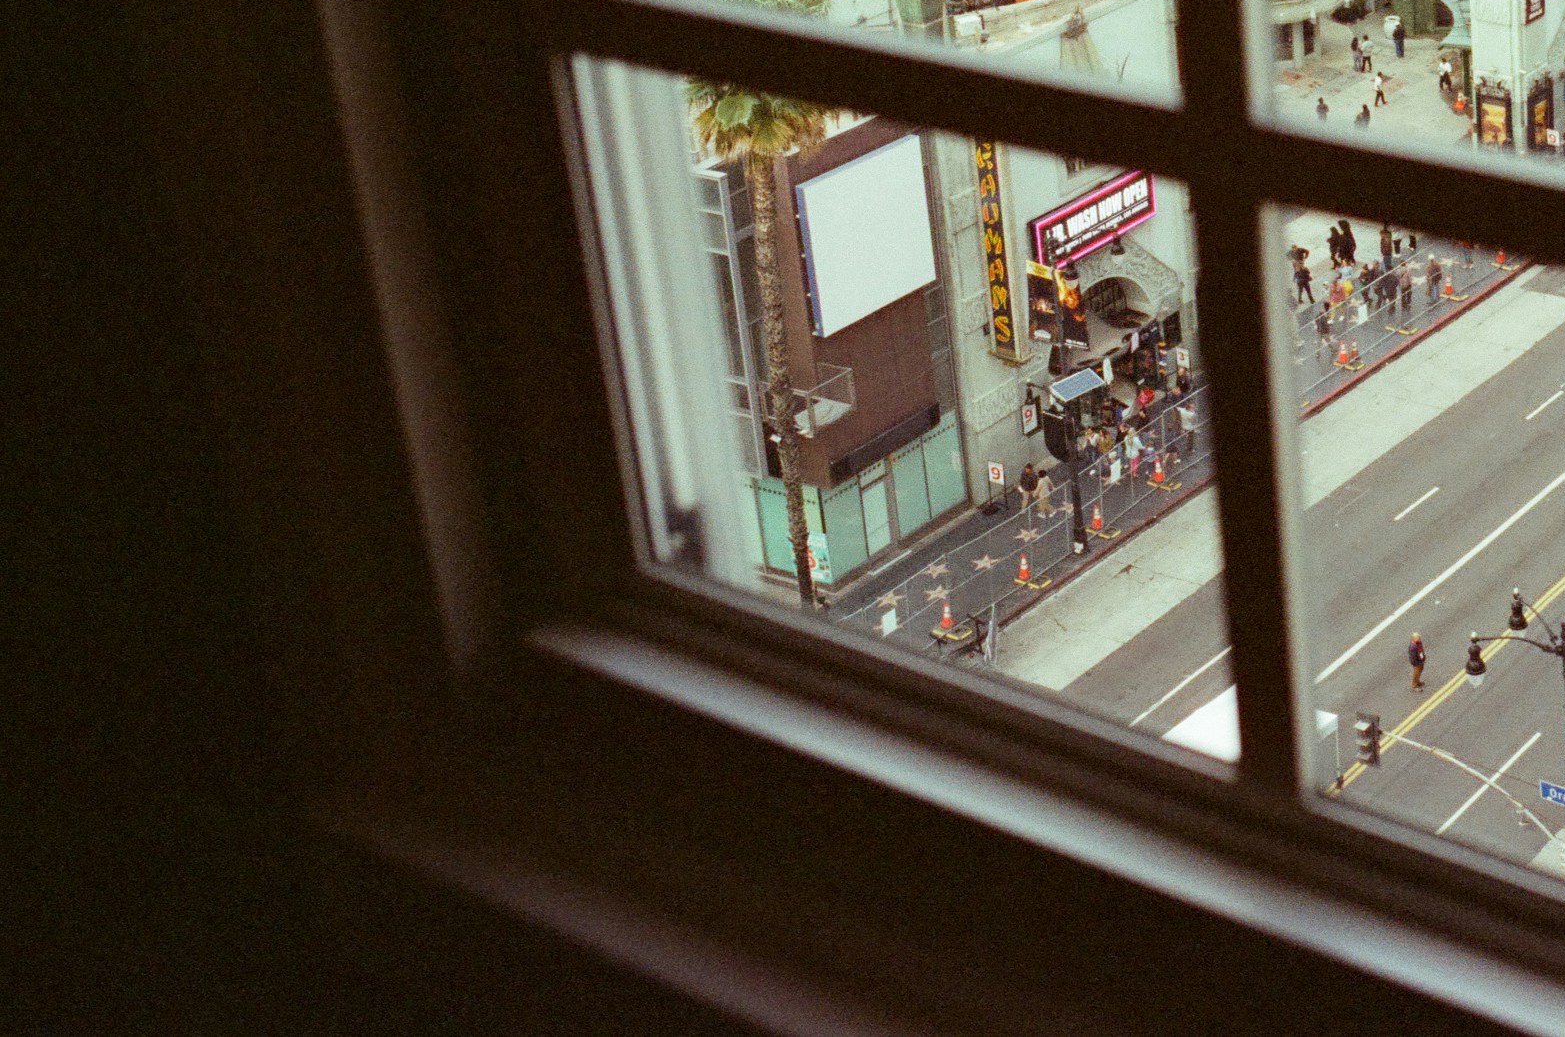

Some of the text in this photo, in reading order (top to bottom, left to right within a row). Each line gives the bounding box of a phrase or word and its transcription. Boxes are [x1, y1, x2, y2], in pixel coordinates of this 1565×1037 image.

[1066, 204, 1099, 238] WASH
[1097, 191, 1123, 222] NOW
[1122, 178, 1149, 208] OPEN
[1024, 409, 1033, 423] 9
[990, 466, 1001, 480] 9
